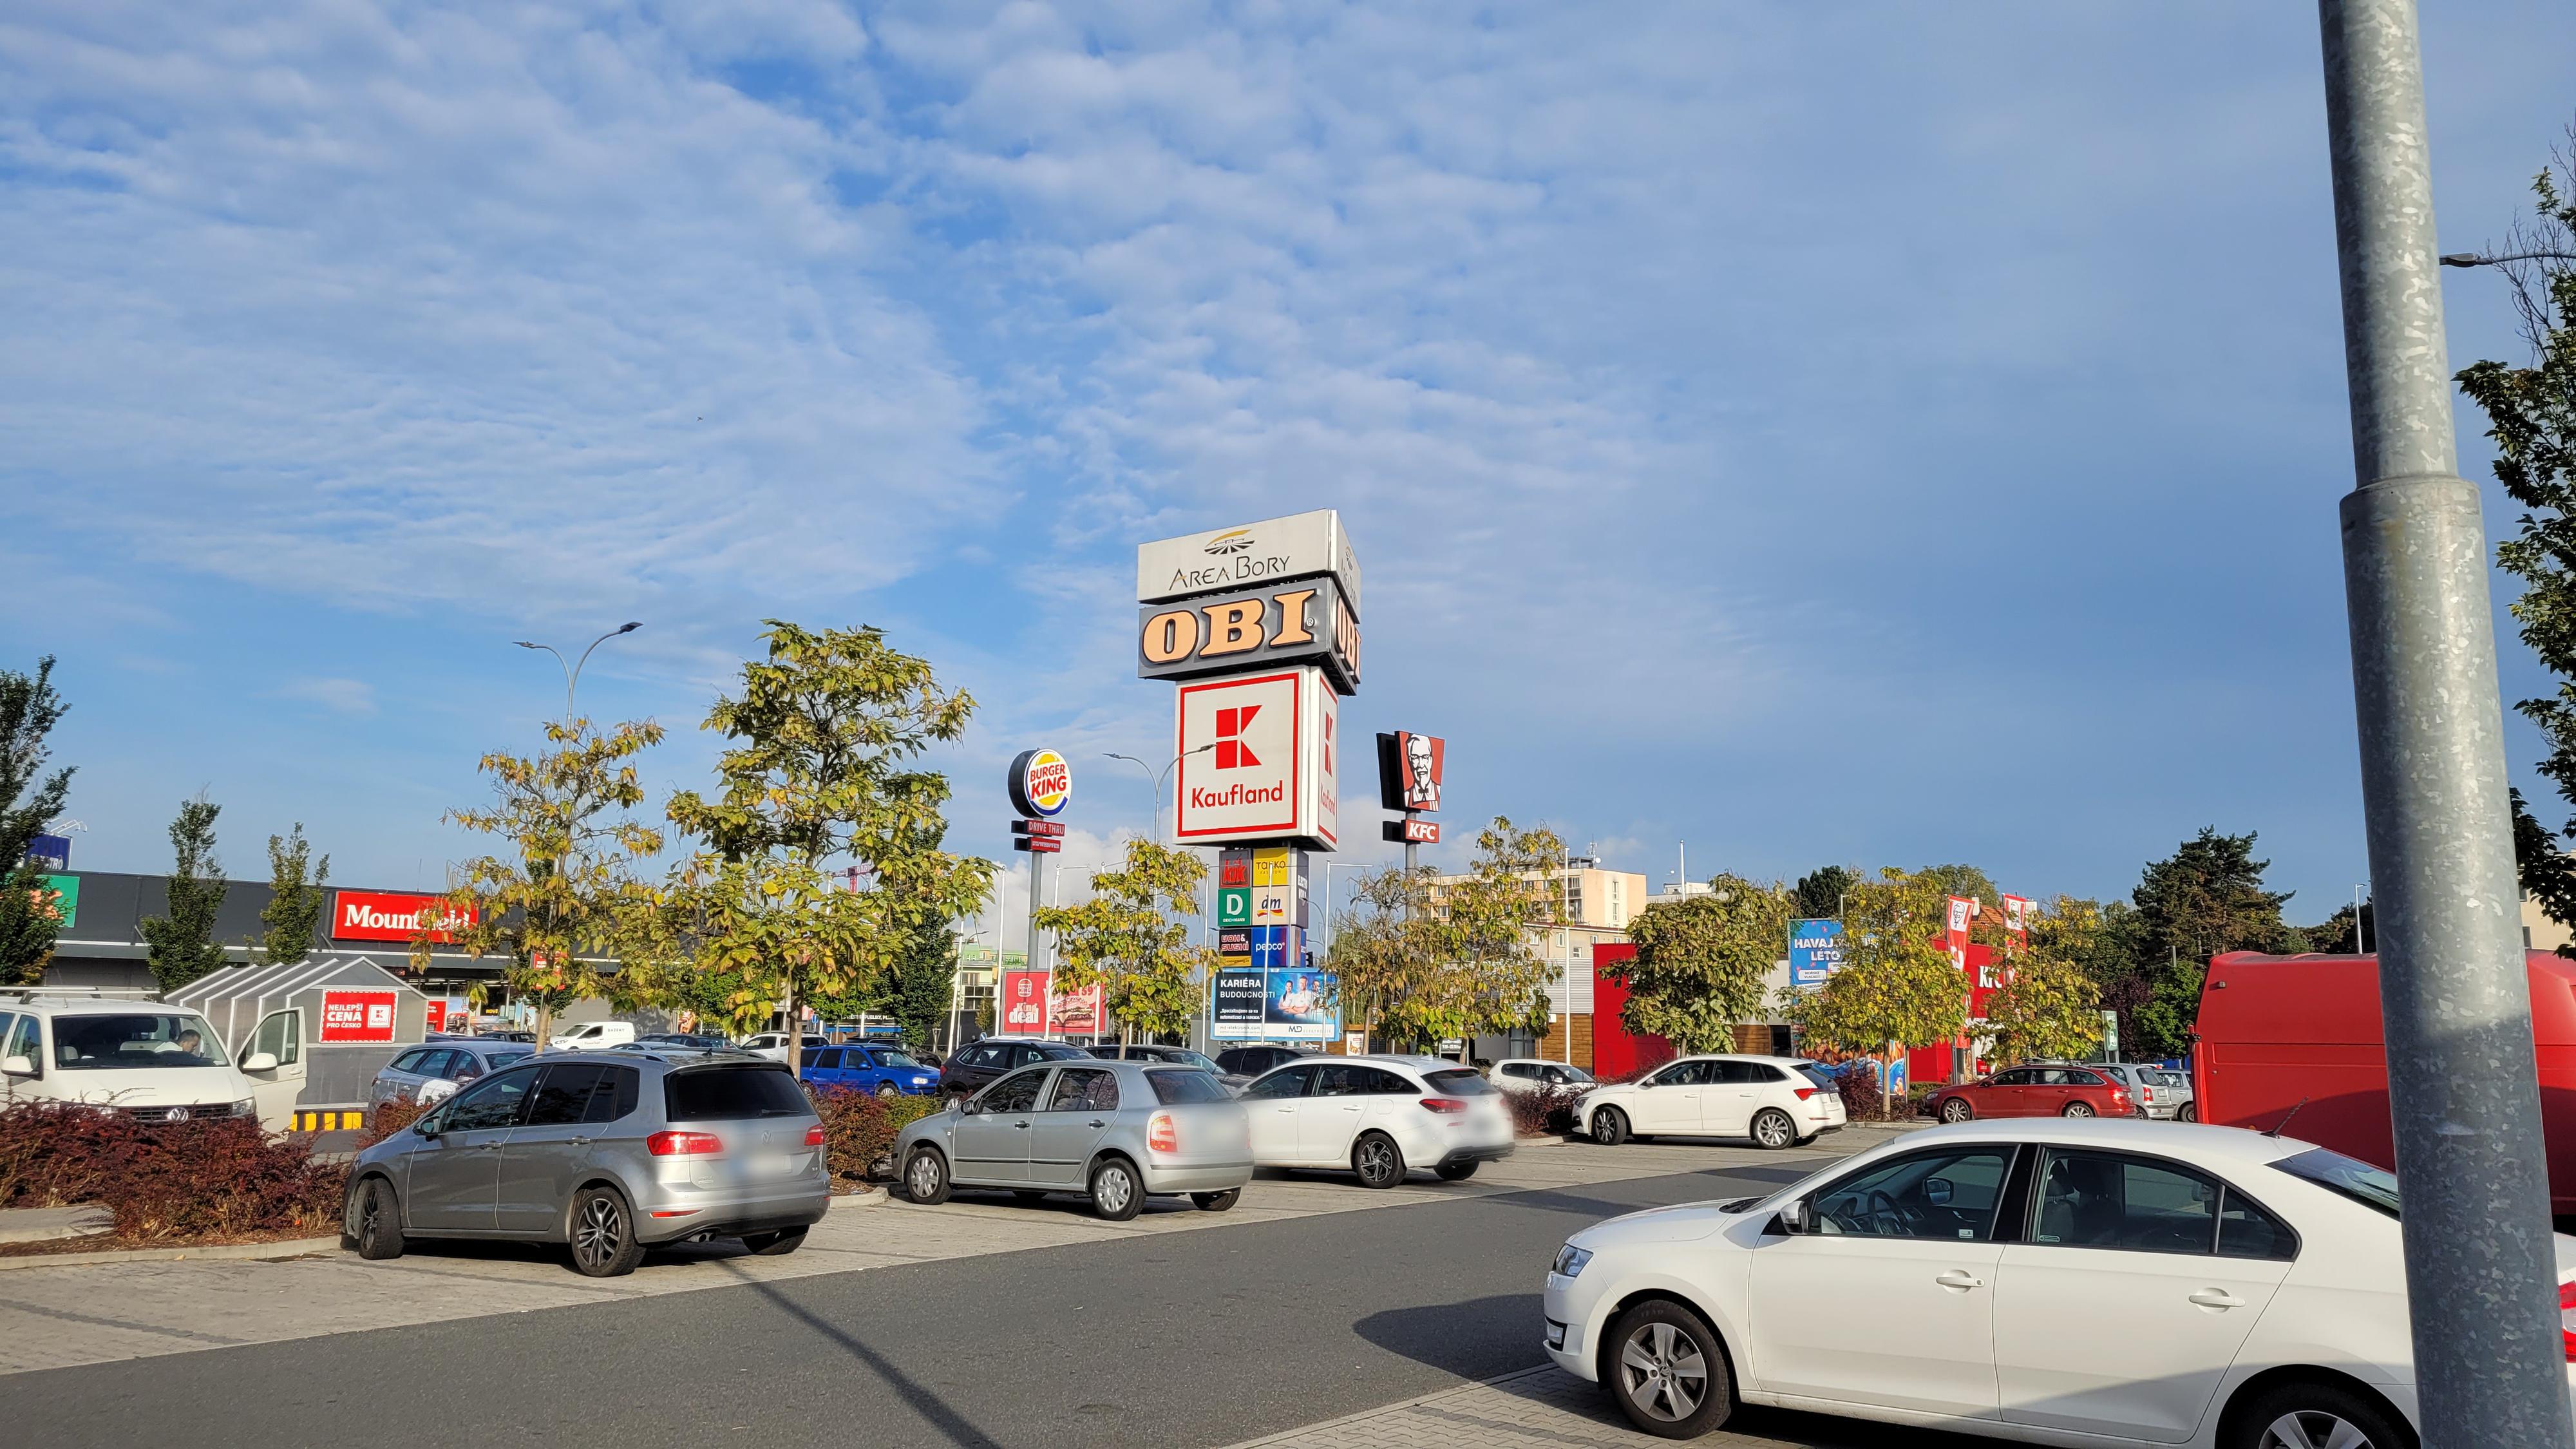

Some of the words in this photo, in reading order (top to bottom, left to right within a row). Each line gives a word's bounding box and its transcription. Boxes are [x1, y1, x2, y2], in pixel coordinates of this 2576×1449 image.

[1169, 567, 1231, 591] AREA
[1235, 555, 1291, 580] BORY
[1142, 589, 1318, 663] OBI
[1030, 764, 1066, 782] BURGER
[1030, 775, 1067, 800] KING
[1191, 780, 1283, 809] Kaufland
[1029, 821, 1047, 832] DRIVE
[1048, 824, 1065, 835] THRU
[1408, 822, 1437, 840] KFC
[1226, 894, 1244, 916] D
[1810, 949, 1841, 961] LÉTO
[1220, 978, 1262, 988] KARIÉRA
[328, 1003, 363, 1012] NEJLEPŠÍ
[1009, 1008, 1039, 1024] deal
[1016, 1002, 1038, 1014] King
[327, 1011, 362, 1022] CENA
